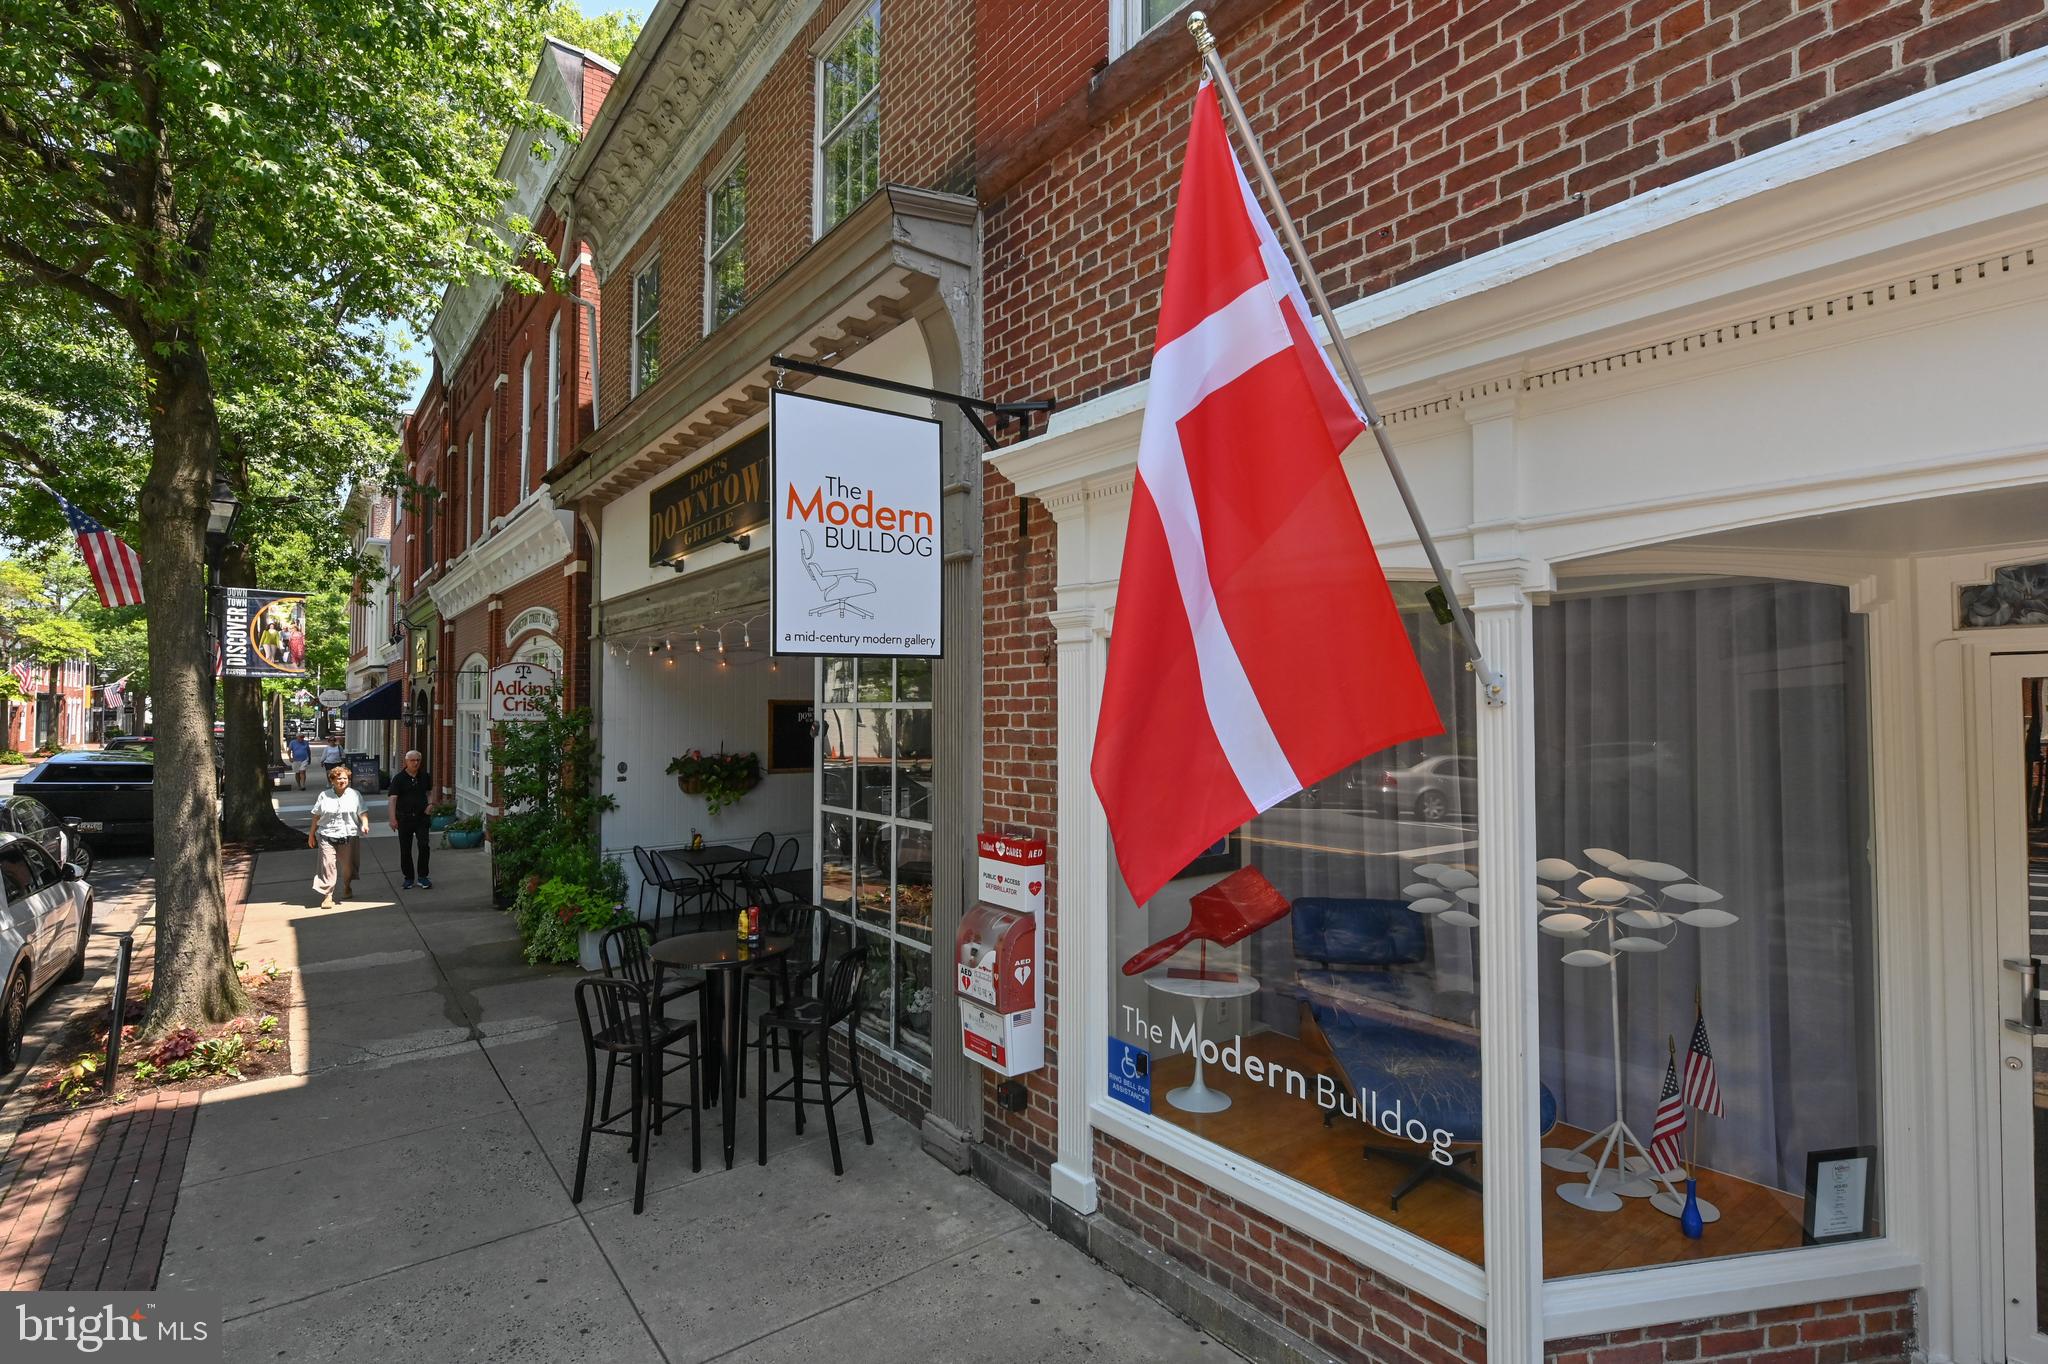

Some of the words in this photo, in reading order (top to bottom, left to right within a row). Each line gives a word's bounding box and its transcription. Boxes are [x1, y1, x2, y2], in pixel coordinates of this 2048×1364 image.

[690, 457, 728, 490] DOC'S
[825, 476, 862, 500] The
[786, 481, 933, 536] Modern
[684, 511, 735, 545] GRILLE
[825, 527, 933, 557] BULLDOG
[227, 598, 248, 607] TOWN
[226, 607, 248, 666] DISCOVER
[785, 634, 792, 642] a
[794, 631, 861, 647] mid-century
[862, 634, 902, 646] modern
[904, 635, 936, 649] gallery
[494, 680, 551, 696] Adkins
[1006, 846, 1023, 858] CARES
[1028, 848, 1043, 859] AED
[983, 872, 997, 881] PUBLIC
[1004, 877, 1021, 887] ACCESS
[985, 882, 1018, 895] DEFIBRILLATOR
[1014, 957, 1031, 966] AED
[960, 966, 972, 977] AED
[1108, 1072, 1122, 1084] RING
[1123, 1078, 1137, 1090] BELL
[1137, 1085, 1150, 1096] FOR
[1112, 1082, 1146, 1103] ASSISTANCE
[1122, 1005, 1163, 1044] The
[1169, 1016, 1306, 1101] Modern
[1317, 1073, 1455, 1167] Bulldog
